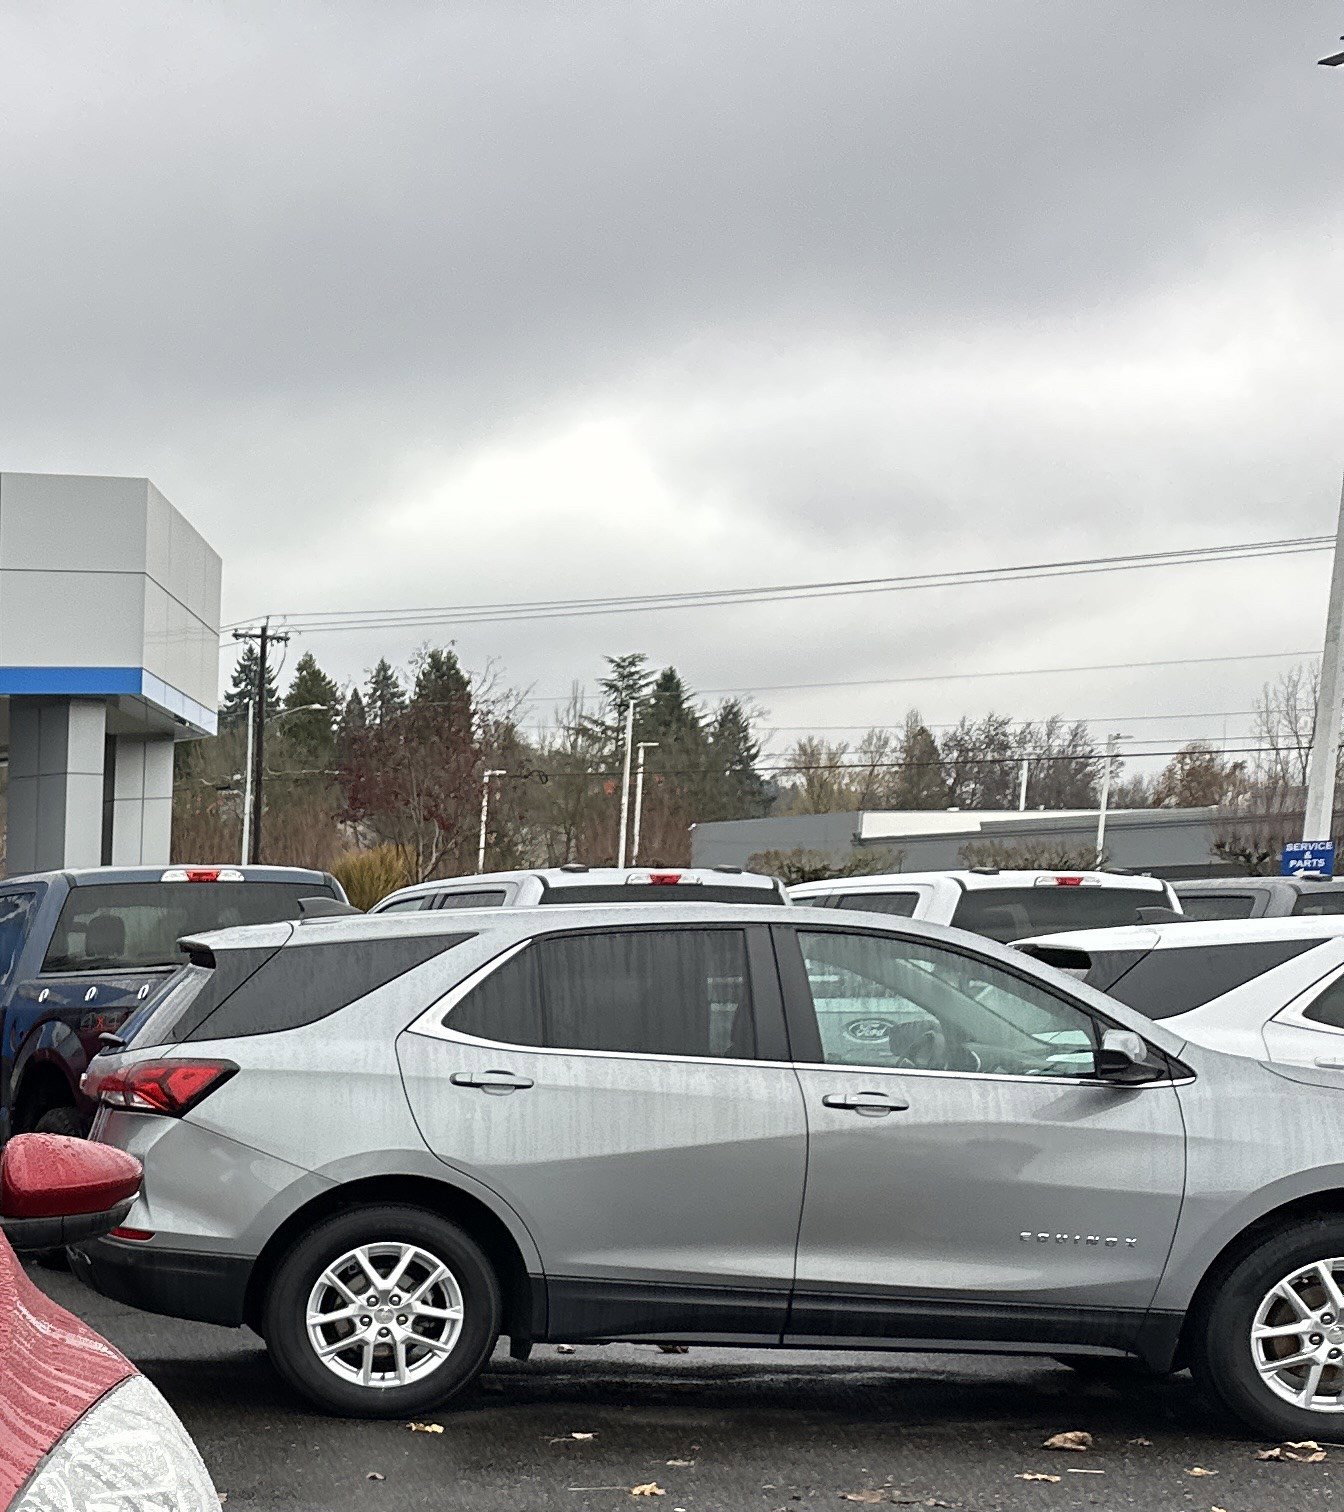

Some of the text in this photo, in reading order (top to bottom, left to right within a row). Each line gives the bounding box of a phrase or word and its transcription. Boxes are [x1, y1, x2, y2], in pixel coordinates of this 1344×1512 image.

[1285, 842, 1333, 851] SERVICE
[1304, 851, 1313, 859] &
[1289, 859, 1326, 868] PARTS
[1019, 1231, 1138, 1248] EQUINOX
